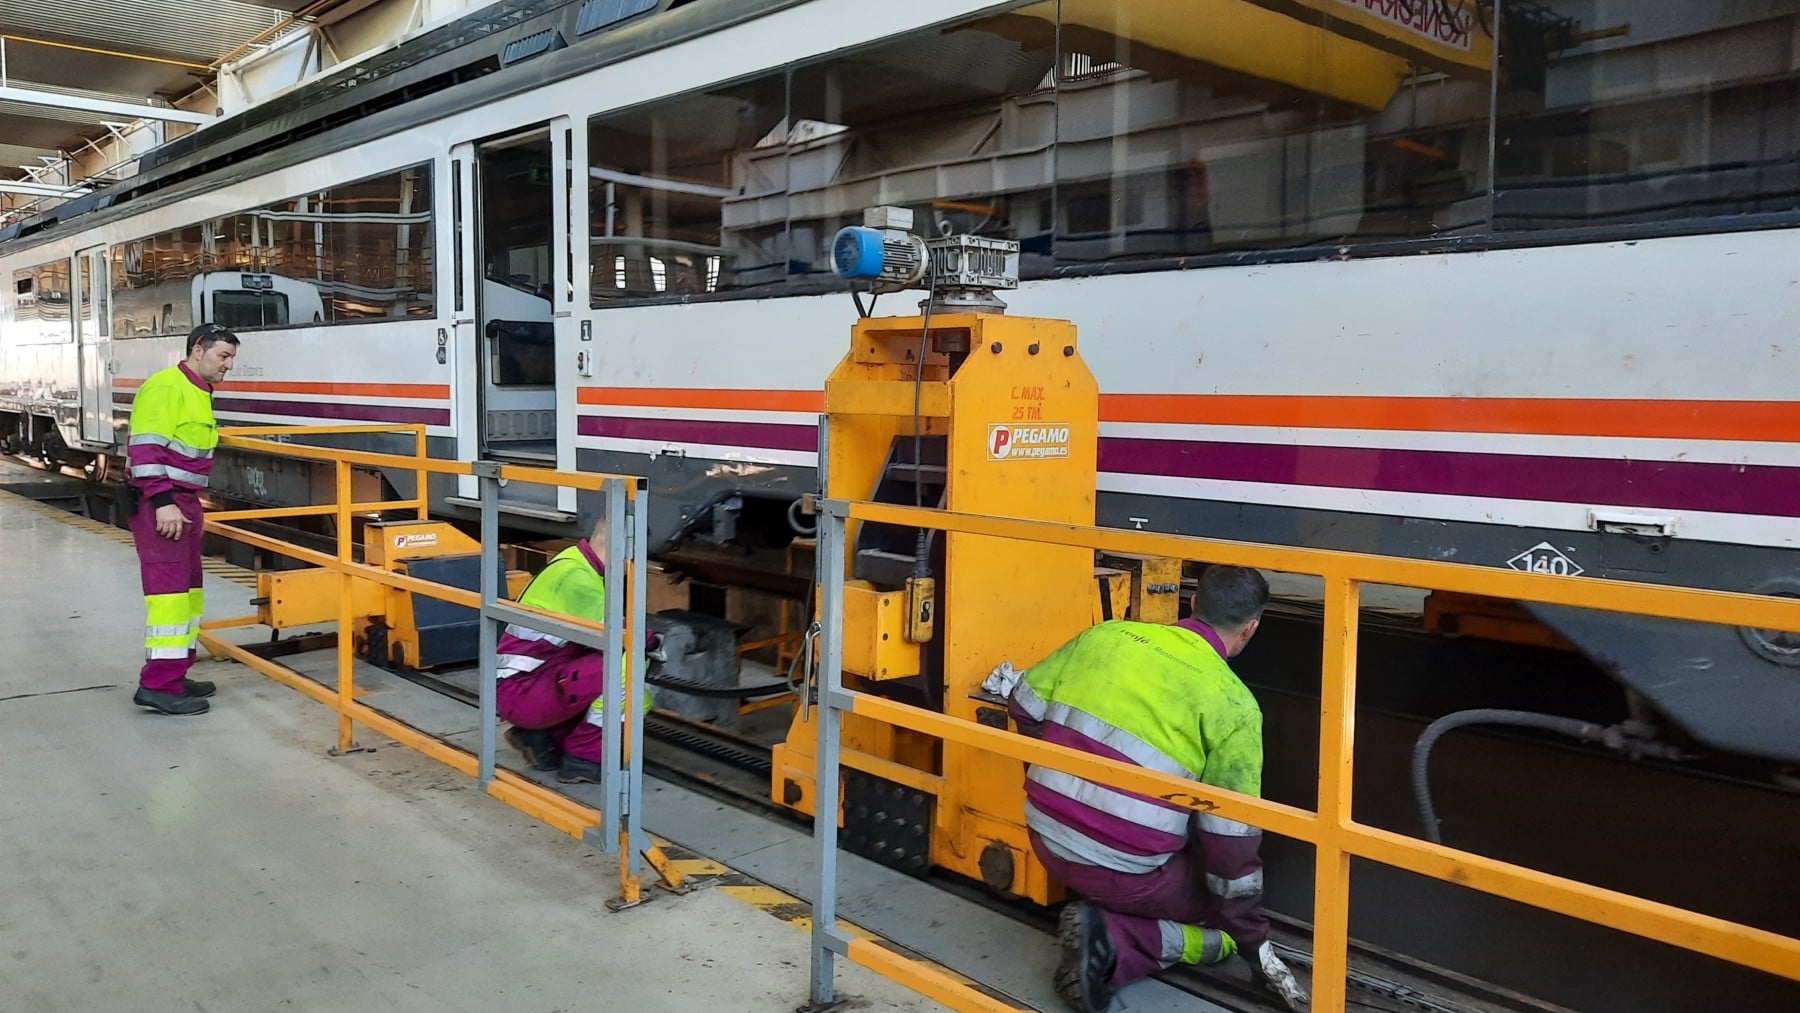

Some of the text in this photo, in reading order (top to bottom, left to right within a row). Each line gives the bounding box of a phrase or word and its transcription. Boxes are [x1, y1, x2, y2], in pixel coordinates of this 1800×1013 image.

[1012, 406, 1024, 420] 25
[1012, 428, 1069, 443] PEGAMO
[1522, 553, 1569, 576] 140
[1120, 629, 1149, 645] renfe
